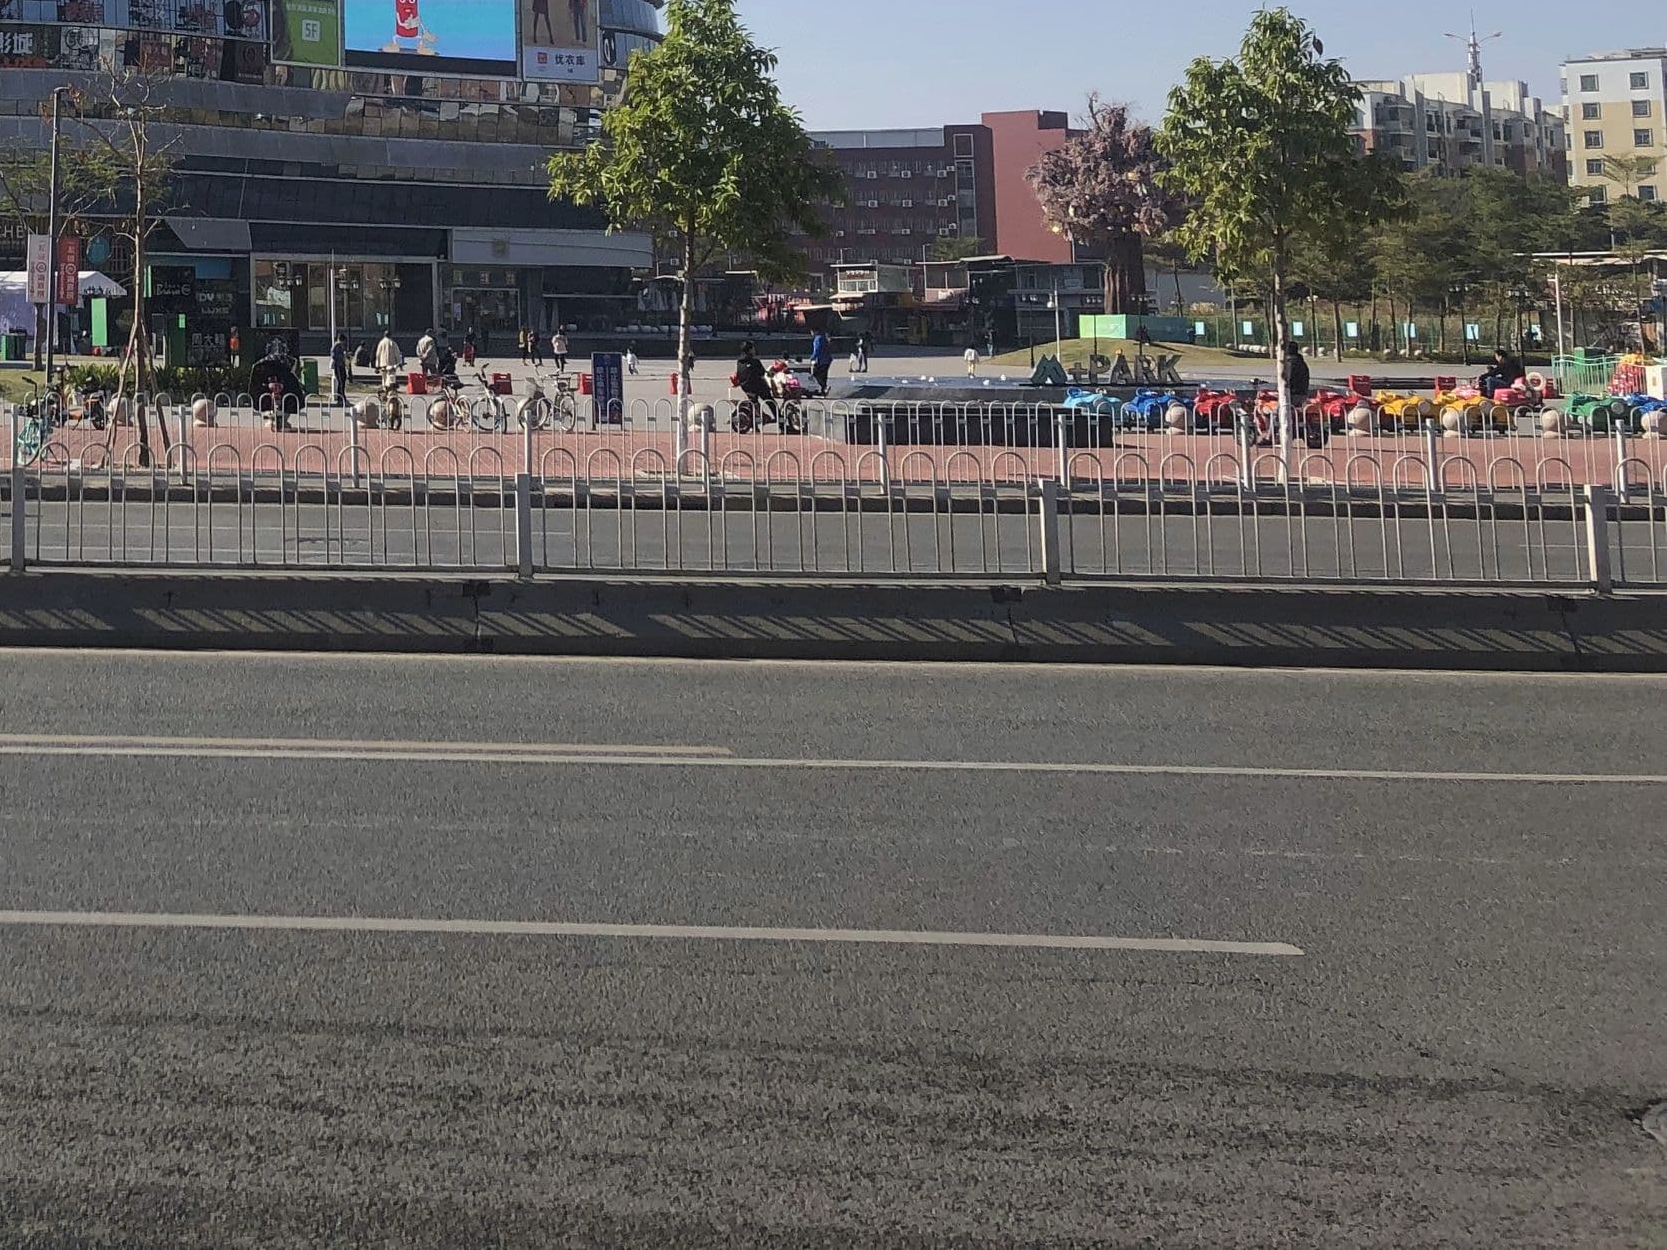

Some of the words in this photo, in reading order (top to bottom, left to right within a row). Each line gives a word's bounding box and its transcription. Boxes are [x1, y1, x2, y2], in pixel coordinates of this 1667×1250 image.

[305, 22, 318, 38] 5F
[555, 53, 586, 66] 优衣库
